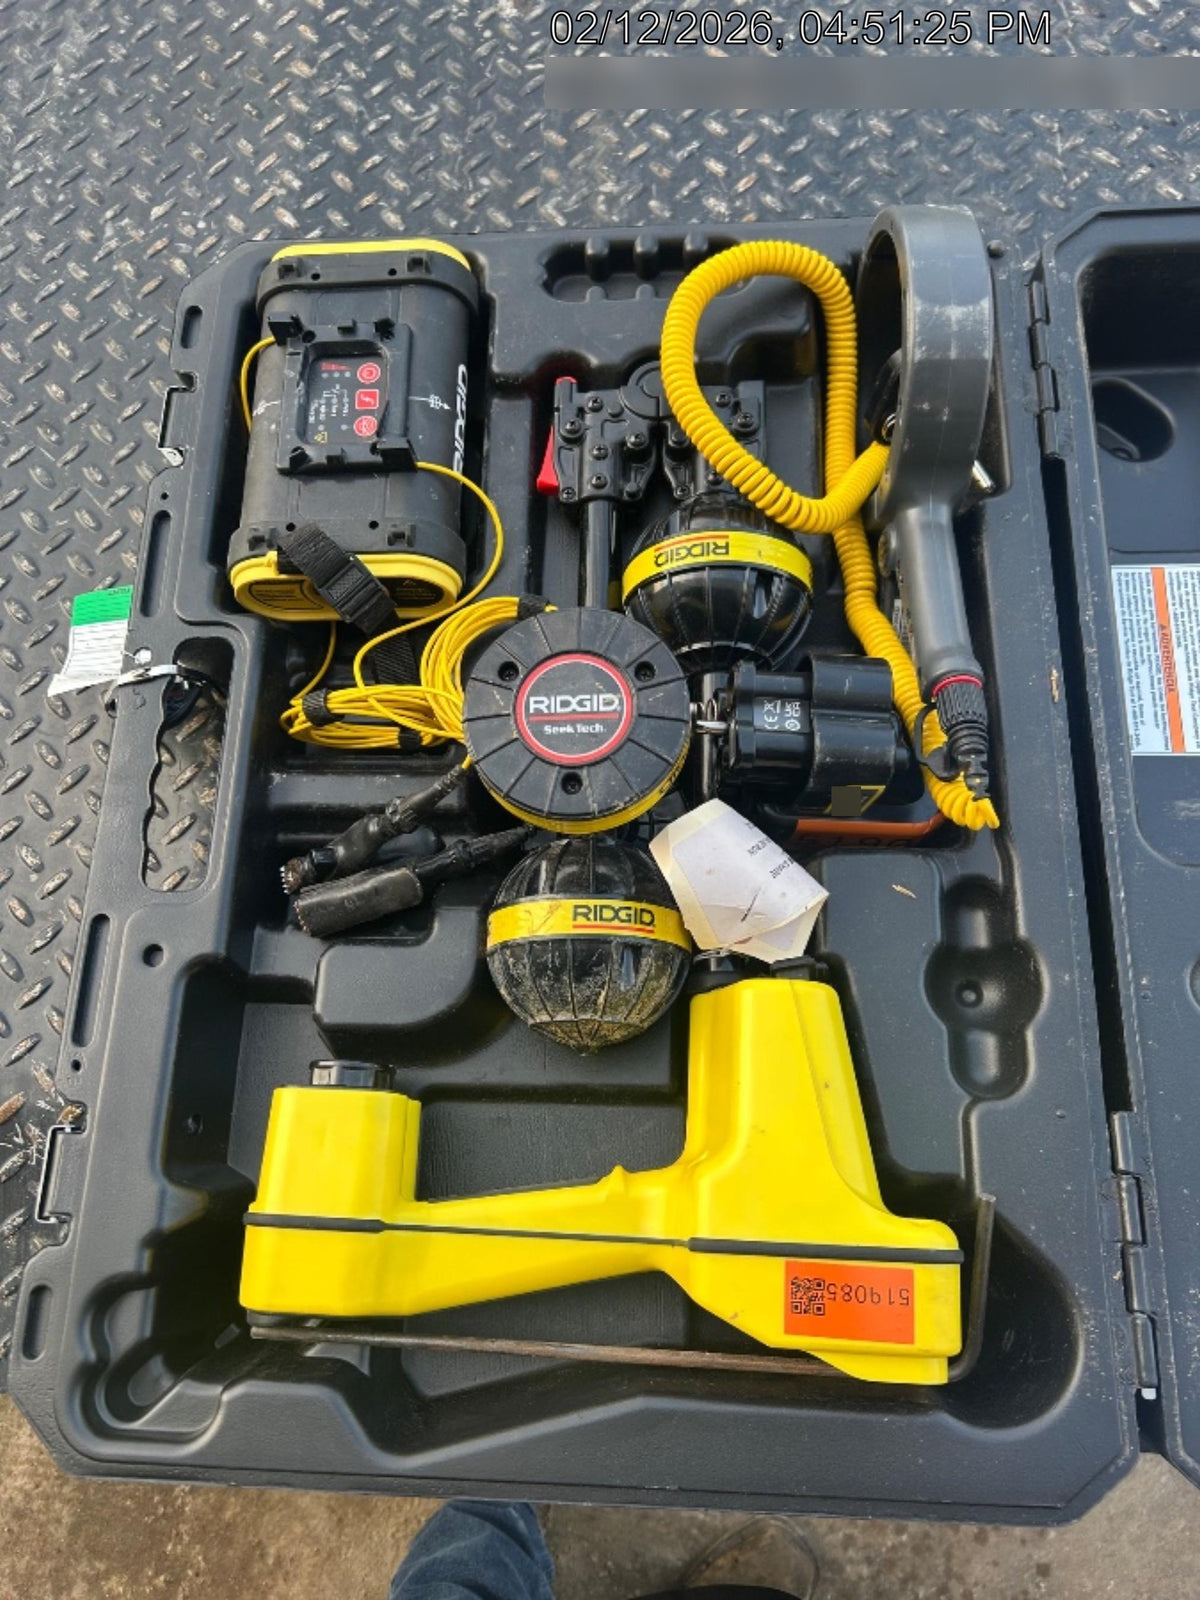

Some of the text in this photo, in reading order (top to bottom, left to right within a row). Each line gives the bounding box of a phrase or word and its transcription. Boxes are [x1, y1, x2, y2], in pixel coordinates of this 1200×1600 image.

[654, 541, 729, 568] RIDGID
[529, 693, 619, 714] RIDGID
[572, 904, 655, 926] RIDGID
[826, 1283, 910, 1306] 519085
